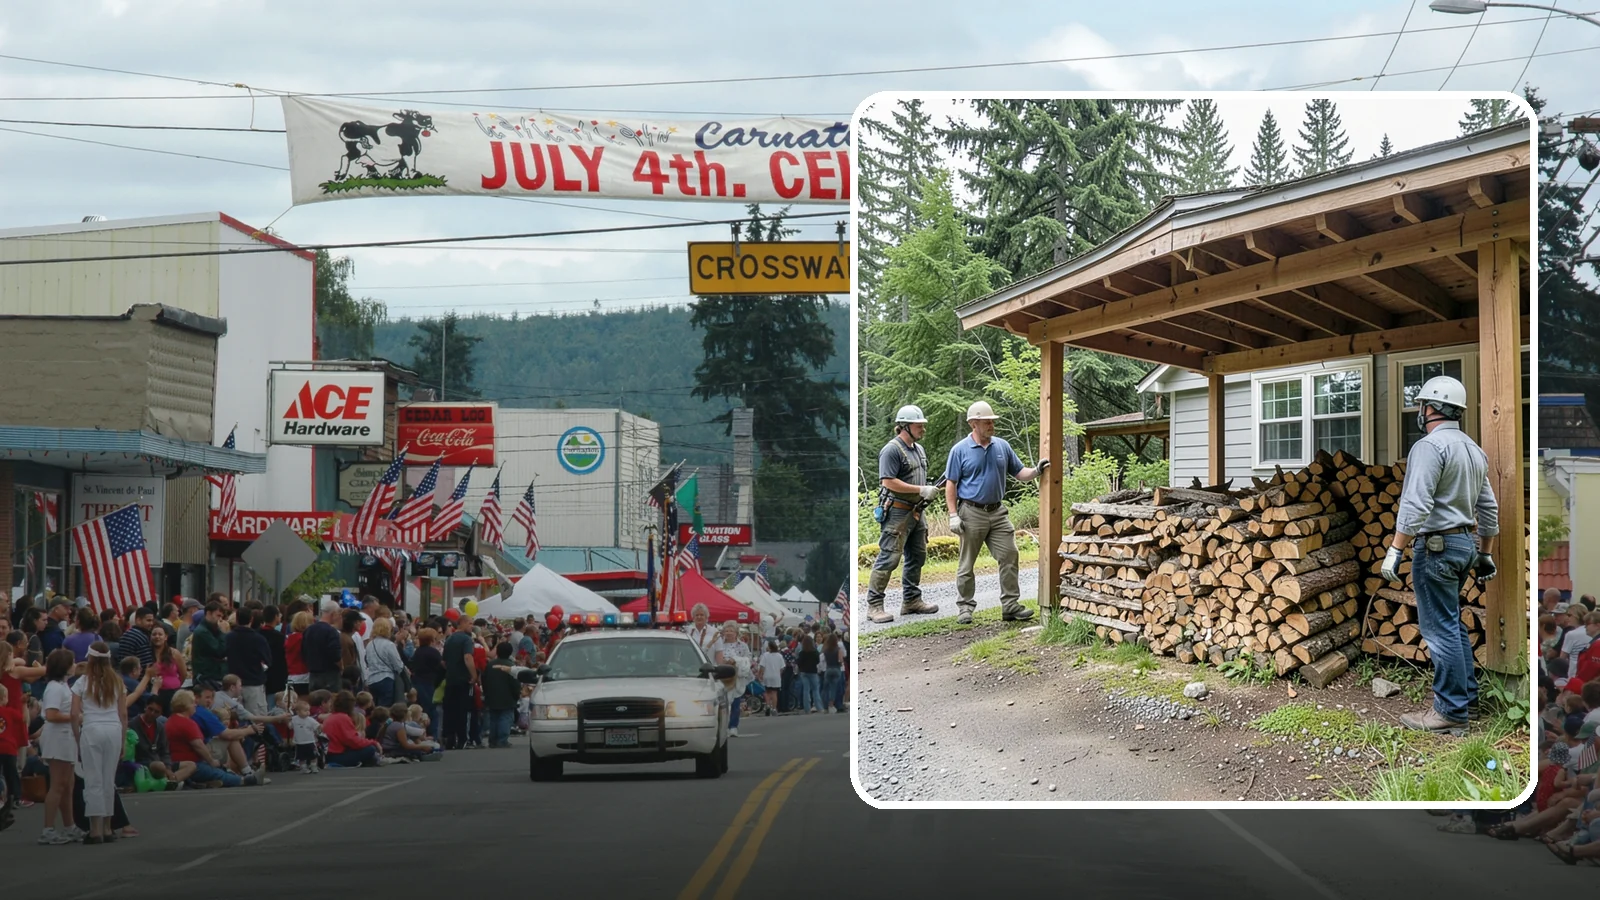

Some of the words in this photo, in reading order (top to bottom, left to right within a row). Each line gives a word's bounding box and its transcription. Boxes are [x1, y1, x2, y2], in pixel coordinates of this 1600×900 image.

[695, 121, 850, 150] Carnat
[481, 141, 605, 193] JULY
[632, 150, 746, 198] 4th.
[697, 254, 850, 280] CROSSWA
[283, 379, 374, 420] ACE
[406, 409, 452, 421] CEDAR
[283, 421, 371, 436] Hardware
[353, 467, 386, 480] Simpl
[96, 486, 124, 494] Vincent
[126, 486, 136, 495] de
[138, 486, 155, 495] Paul
